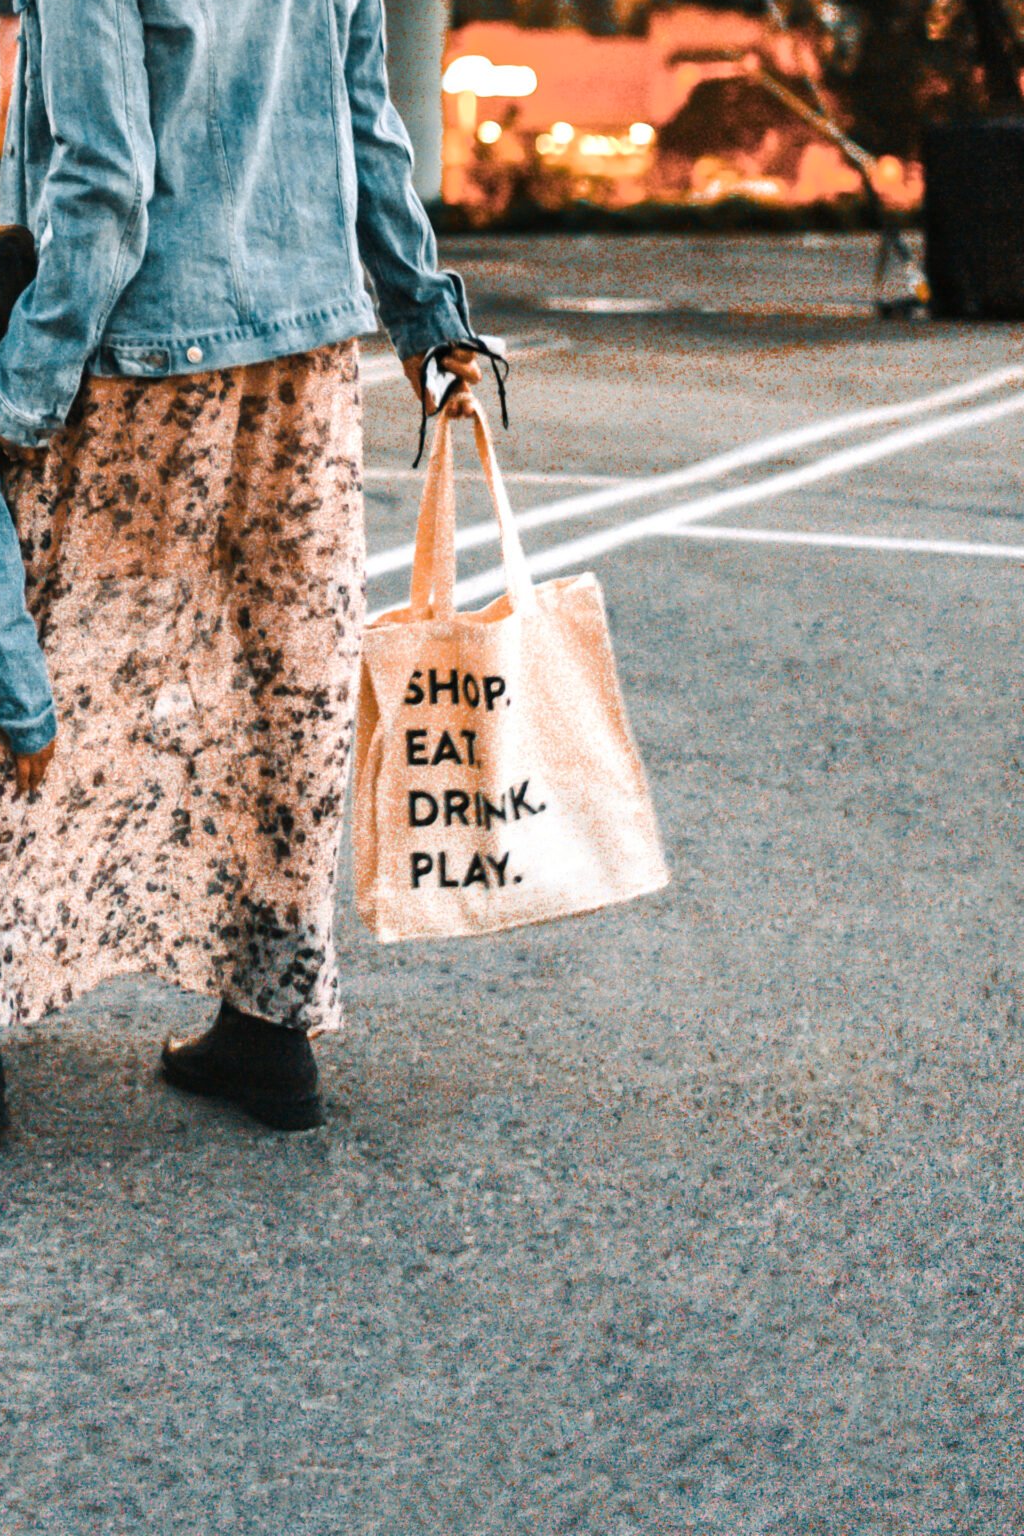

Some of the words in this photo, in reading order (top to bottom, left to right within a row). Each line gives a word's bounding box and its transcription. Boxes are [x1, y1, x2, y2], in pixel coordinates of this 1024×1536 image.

[404, 668, 511, 711] SHOP.
[408, 779, 546, 831] DRINK.
[410, 851, 523, 889] PLAY.
